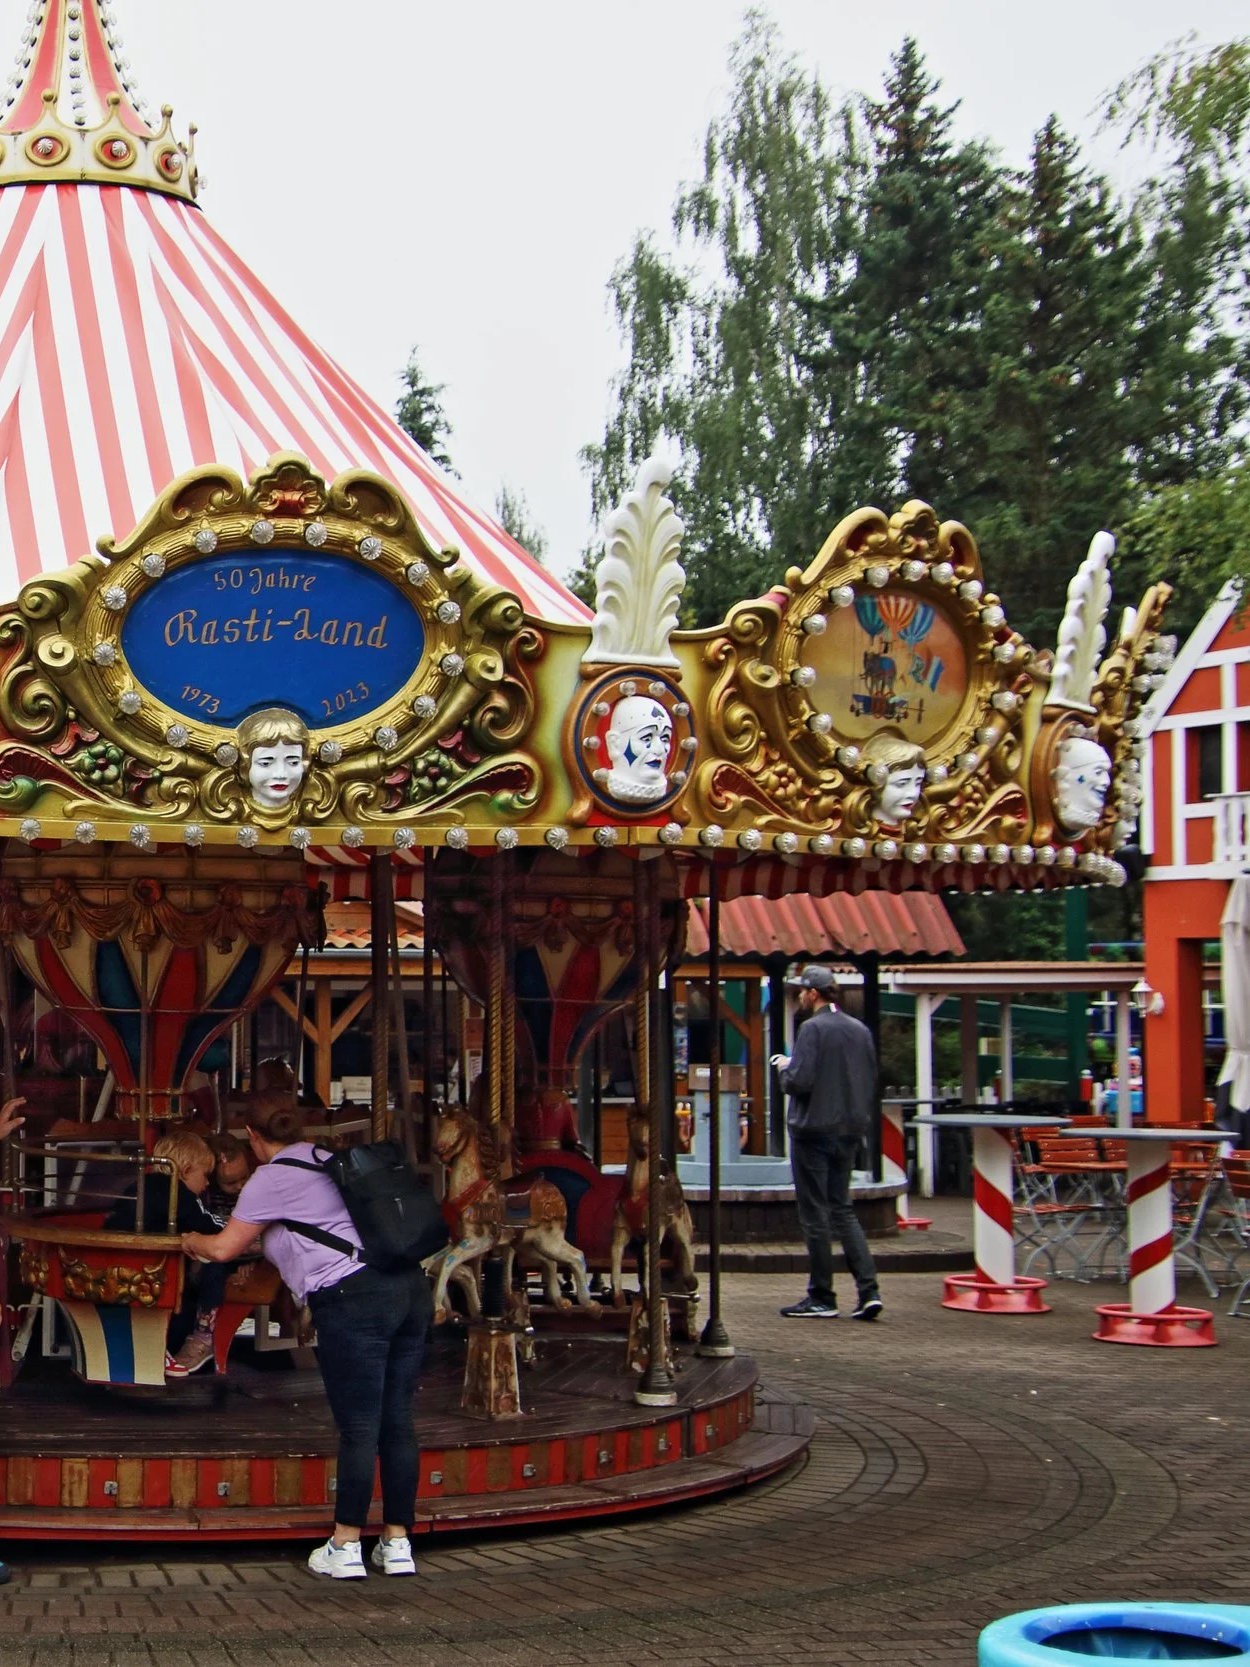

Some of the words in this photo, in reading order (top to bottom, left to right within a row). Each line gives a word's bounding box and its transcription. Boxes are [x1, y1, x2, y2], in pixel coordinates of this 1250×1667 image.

[213, 568, 244, 591] 50
[249, 566, 317, 595] Jahre
[163, 607, 389, 649] Rasti-Land
[181, 685, 222, 714] 1973
[323, 682, 371, 717] 2023
